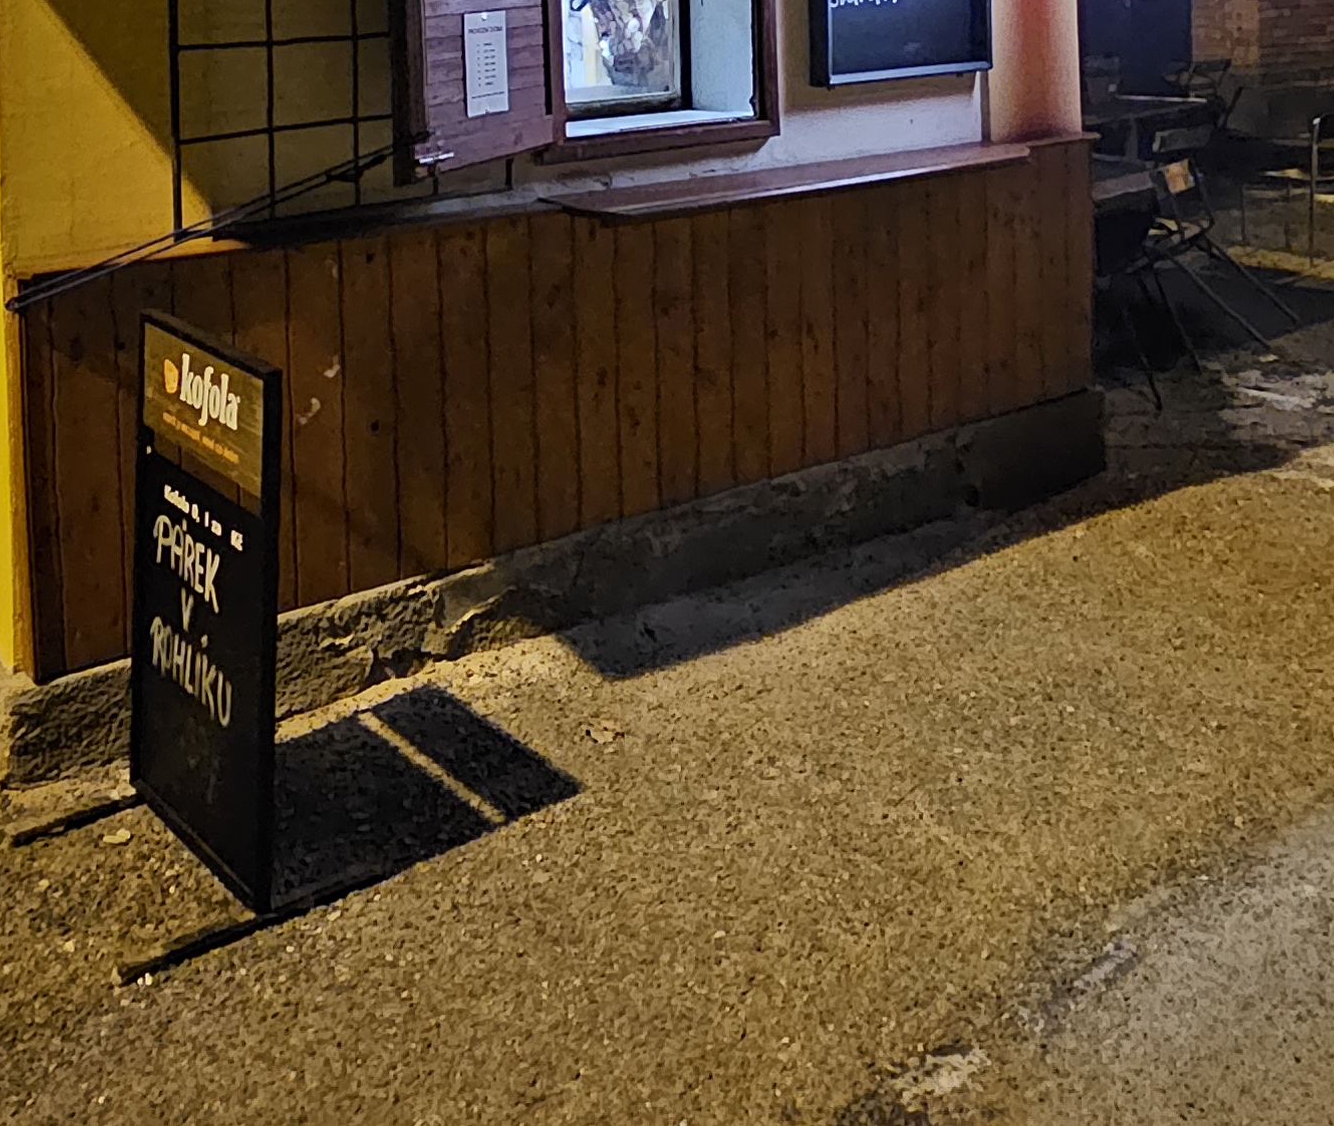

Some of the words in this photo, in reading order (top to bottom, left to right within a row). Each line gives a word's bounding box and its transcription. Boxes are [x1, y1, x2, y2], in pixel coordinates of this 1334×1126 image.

[179, 353, 239, 431] kofola
[153, 514, 220, 614] PÁREK
[150, 616, 233, 728] ROHLÍKU
